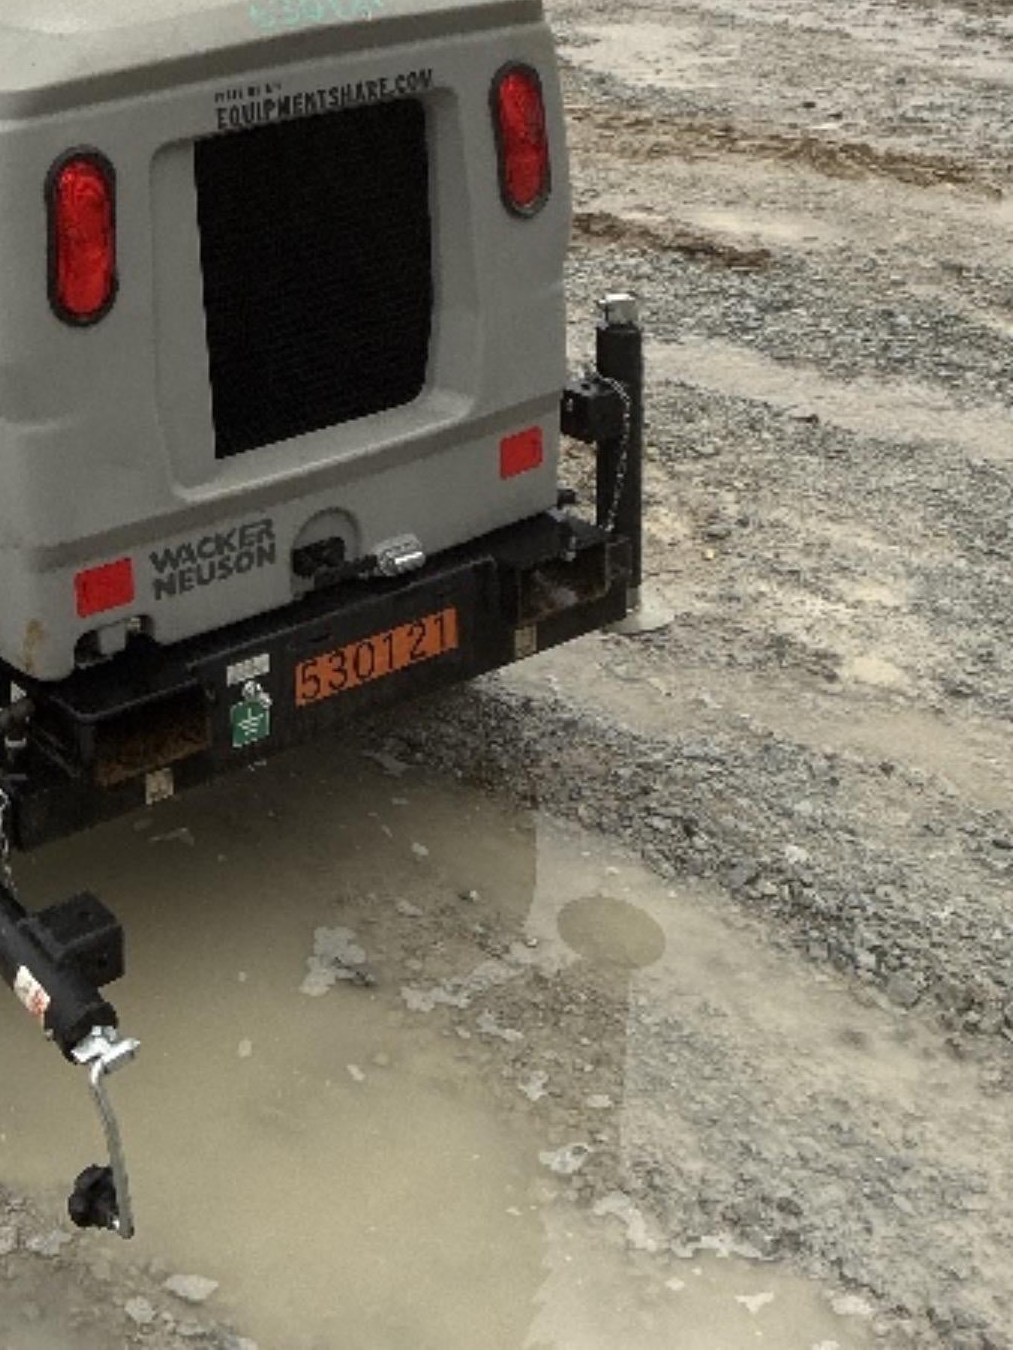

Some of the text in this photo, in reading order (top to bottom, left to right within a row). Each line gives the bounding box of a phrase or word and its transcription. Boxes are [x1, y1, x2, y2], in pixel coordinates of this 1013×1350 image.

[149, 518, 275, 574] WACKER
[153, 542, 276, 600] NEUSON
[301, 614, 445, 699] 530121
